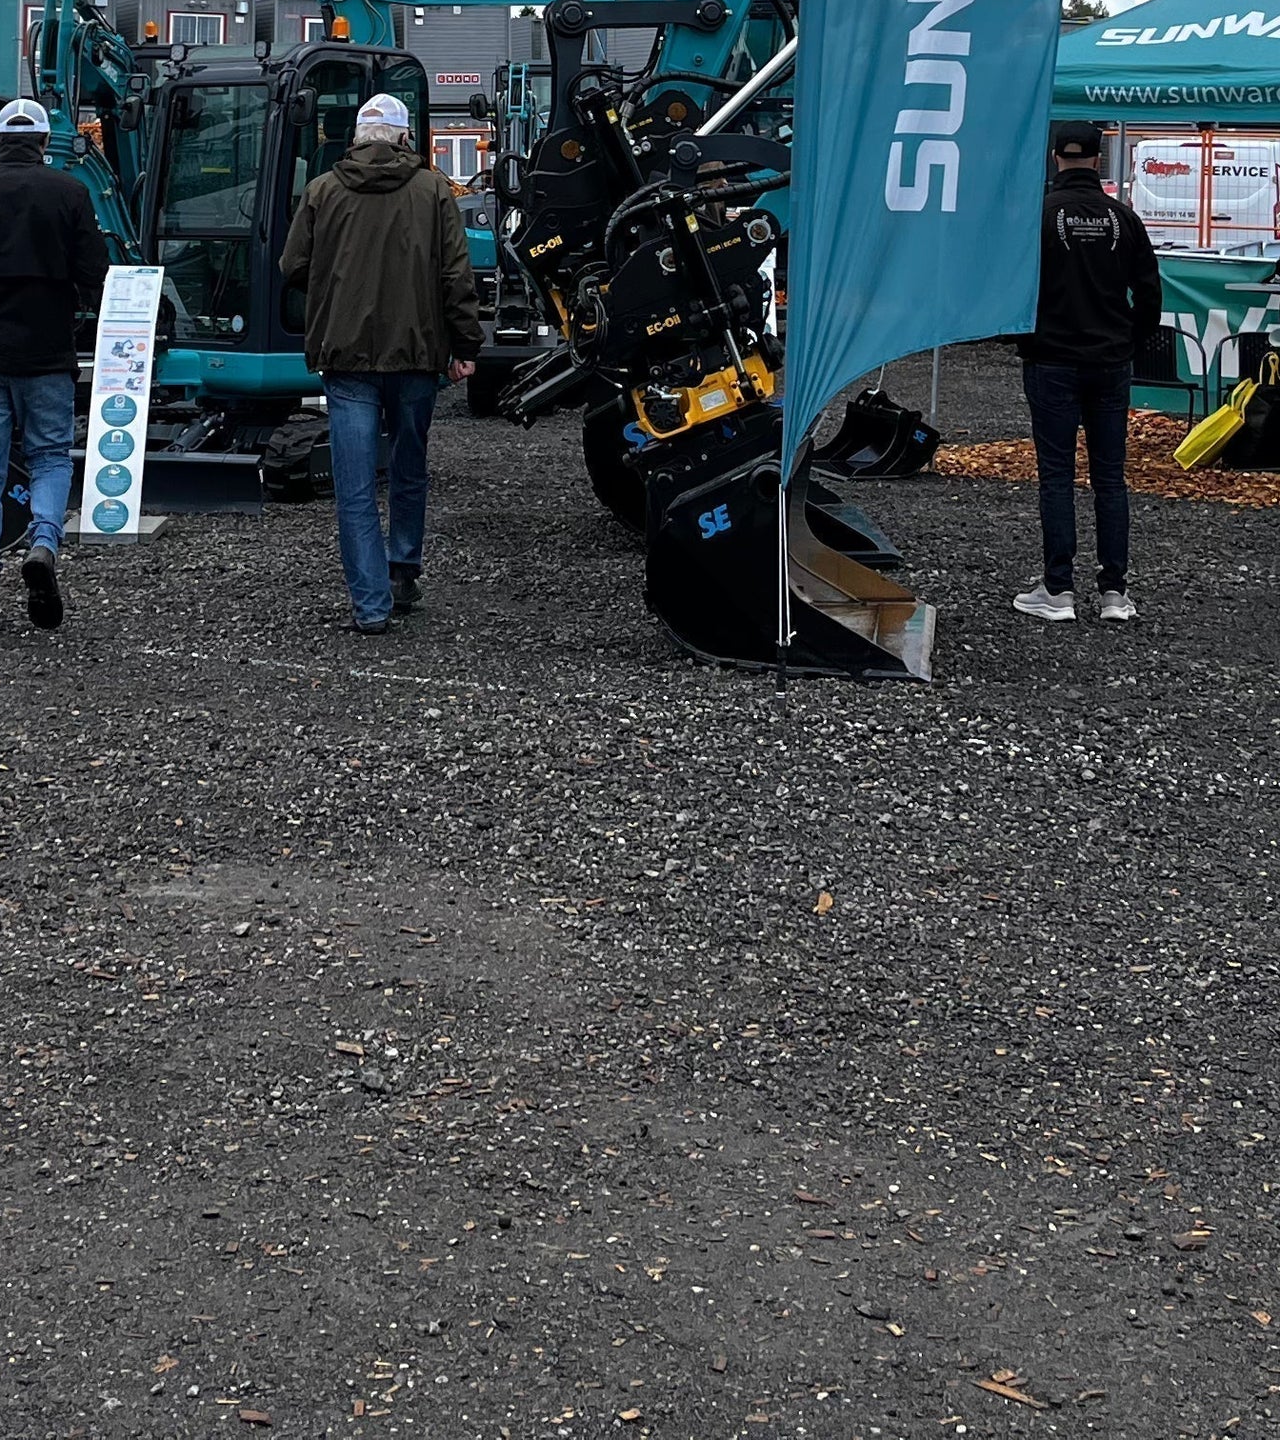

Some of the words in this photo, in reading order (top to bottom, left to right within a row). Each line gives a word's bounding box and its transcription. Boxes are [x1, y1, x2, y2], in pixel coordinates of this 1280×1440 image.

[529, 235, 564, 258] EC-Oil
[646, 314, 682, 336] EC-Oil
[698, 503, 733, 540] SE
